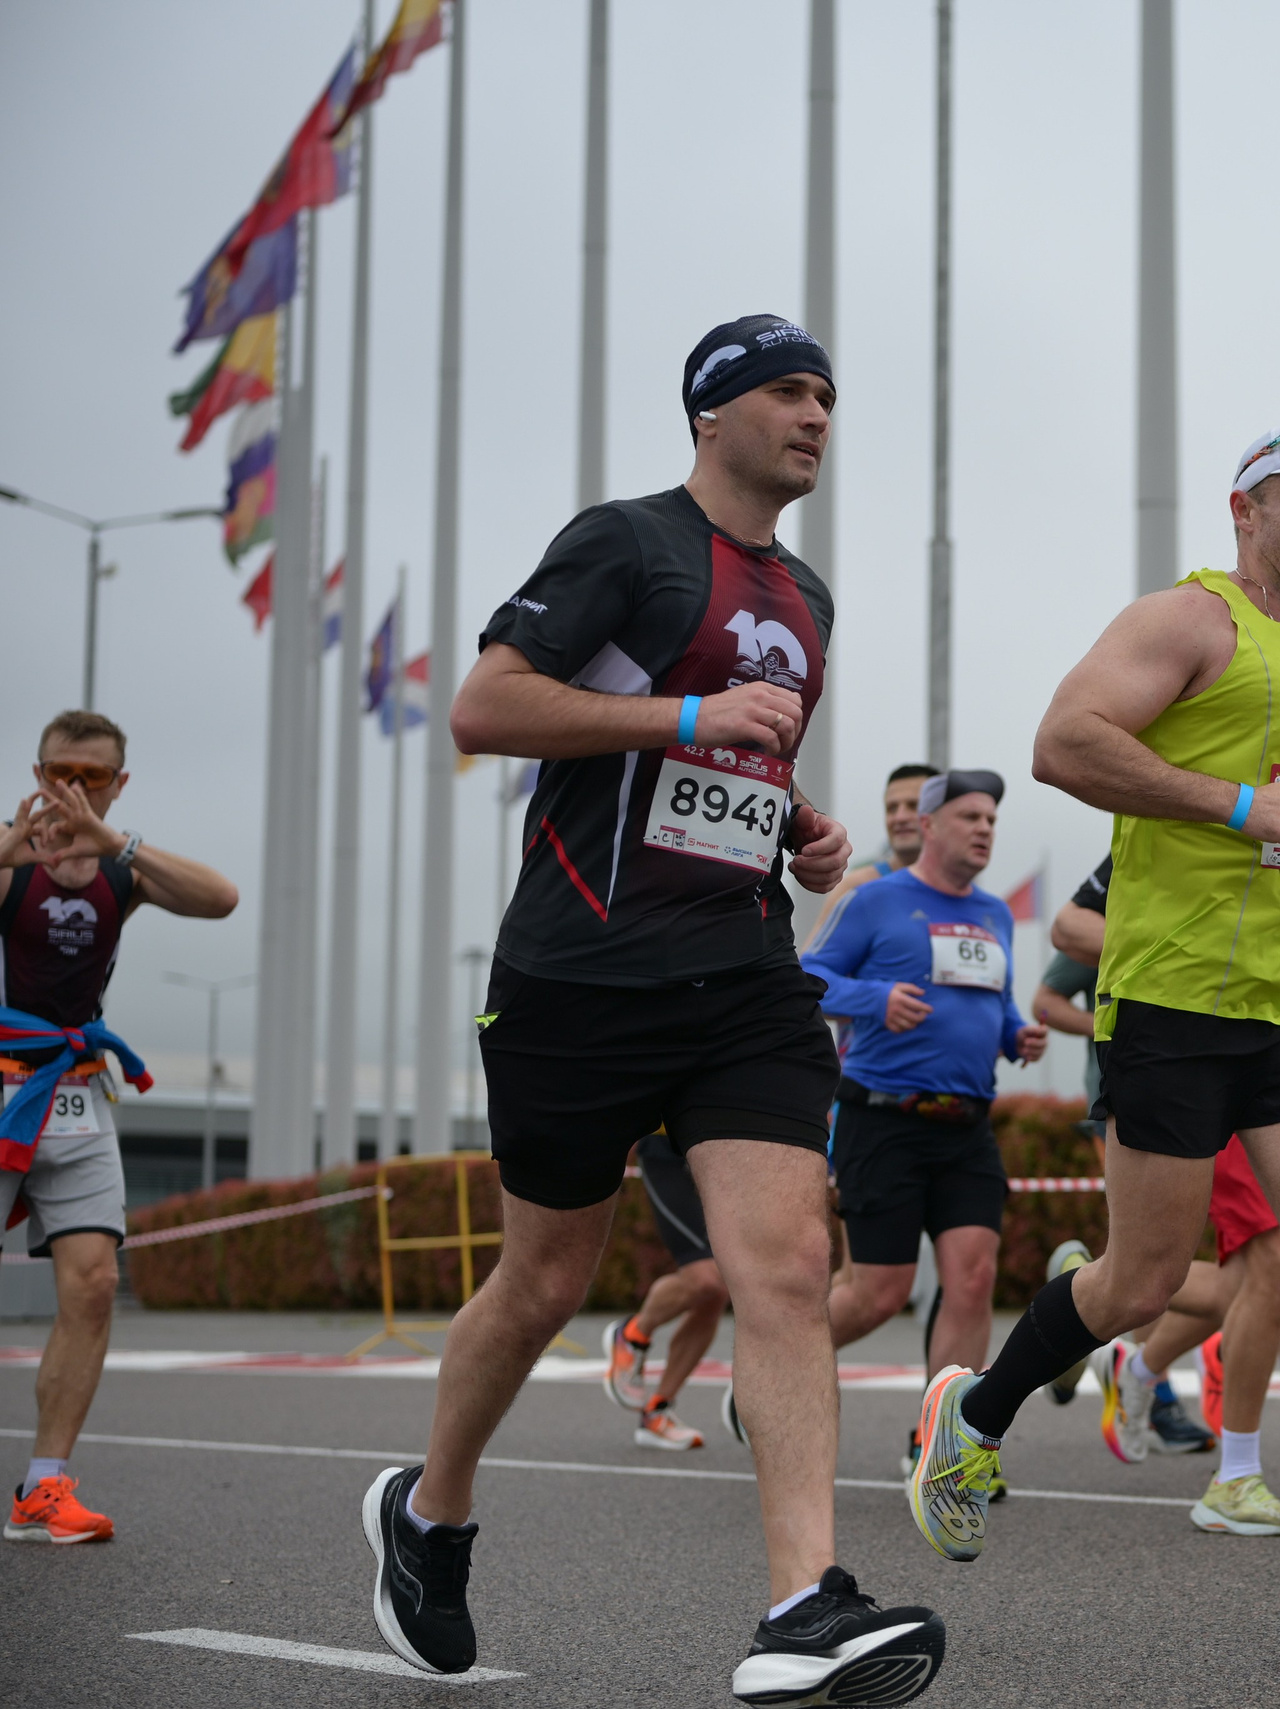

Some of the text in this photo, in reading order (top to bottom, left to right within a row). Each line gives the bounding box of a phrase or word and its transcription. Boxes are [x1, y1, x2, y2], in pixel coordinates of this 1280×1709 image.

[507, 596, 548, 614] АГНИТ
[684, 745, 705, 757] 42.2
[739, 760, 768, 773] SIRIUS
[670, 777, 777, 837] 8943
[696, 841, 720, 850] МАГНИТ
[48, 928, 94, 940] SIRIUS
[959, 940, 987, 962] 66
[54, 1093, 85, 1116] 39
